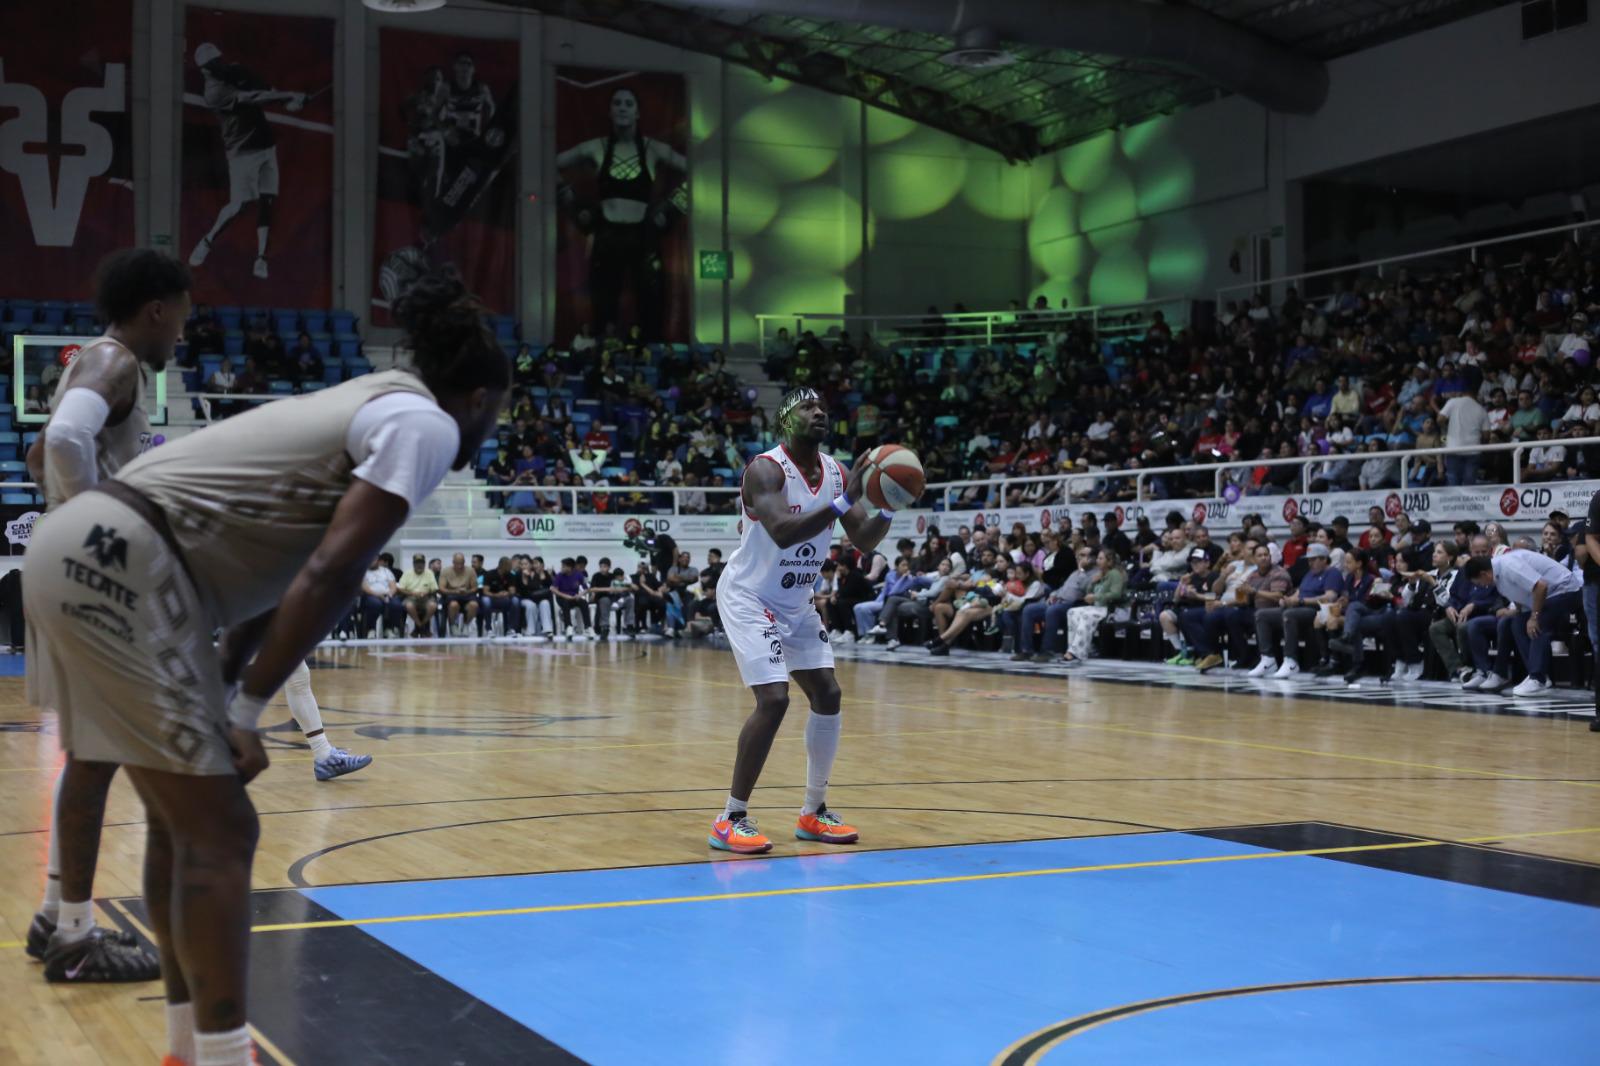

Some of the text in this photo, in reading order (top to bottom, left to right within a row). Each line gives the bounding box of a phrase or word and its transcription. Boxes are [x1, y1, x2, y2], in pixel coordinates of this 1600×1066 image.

[1403, 493, 1430, 512] UAD
[1520, 488, 1552, 508] CID
[1125, 505, 1144, 520] CID
[1207, 502, 1230, 518] UAD
[1299, 498, 1323, 516] CID
[527, 518, 554, 532] UAD
[643, 519, 670, 532] CID
[779, 559, 823, 567] Banco Aztec
[62, 557, 139, 612] TECATE
